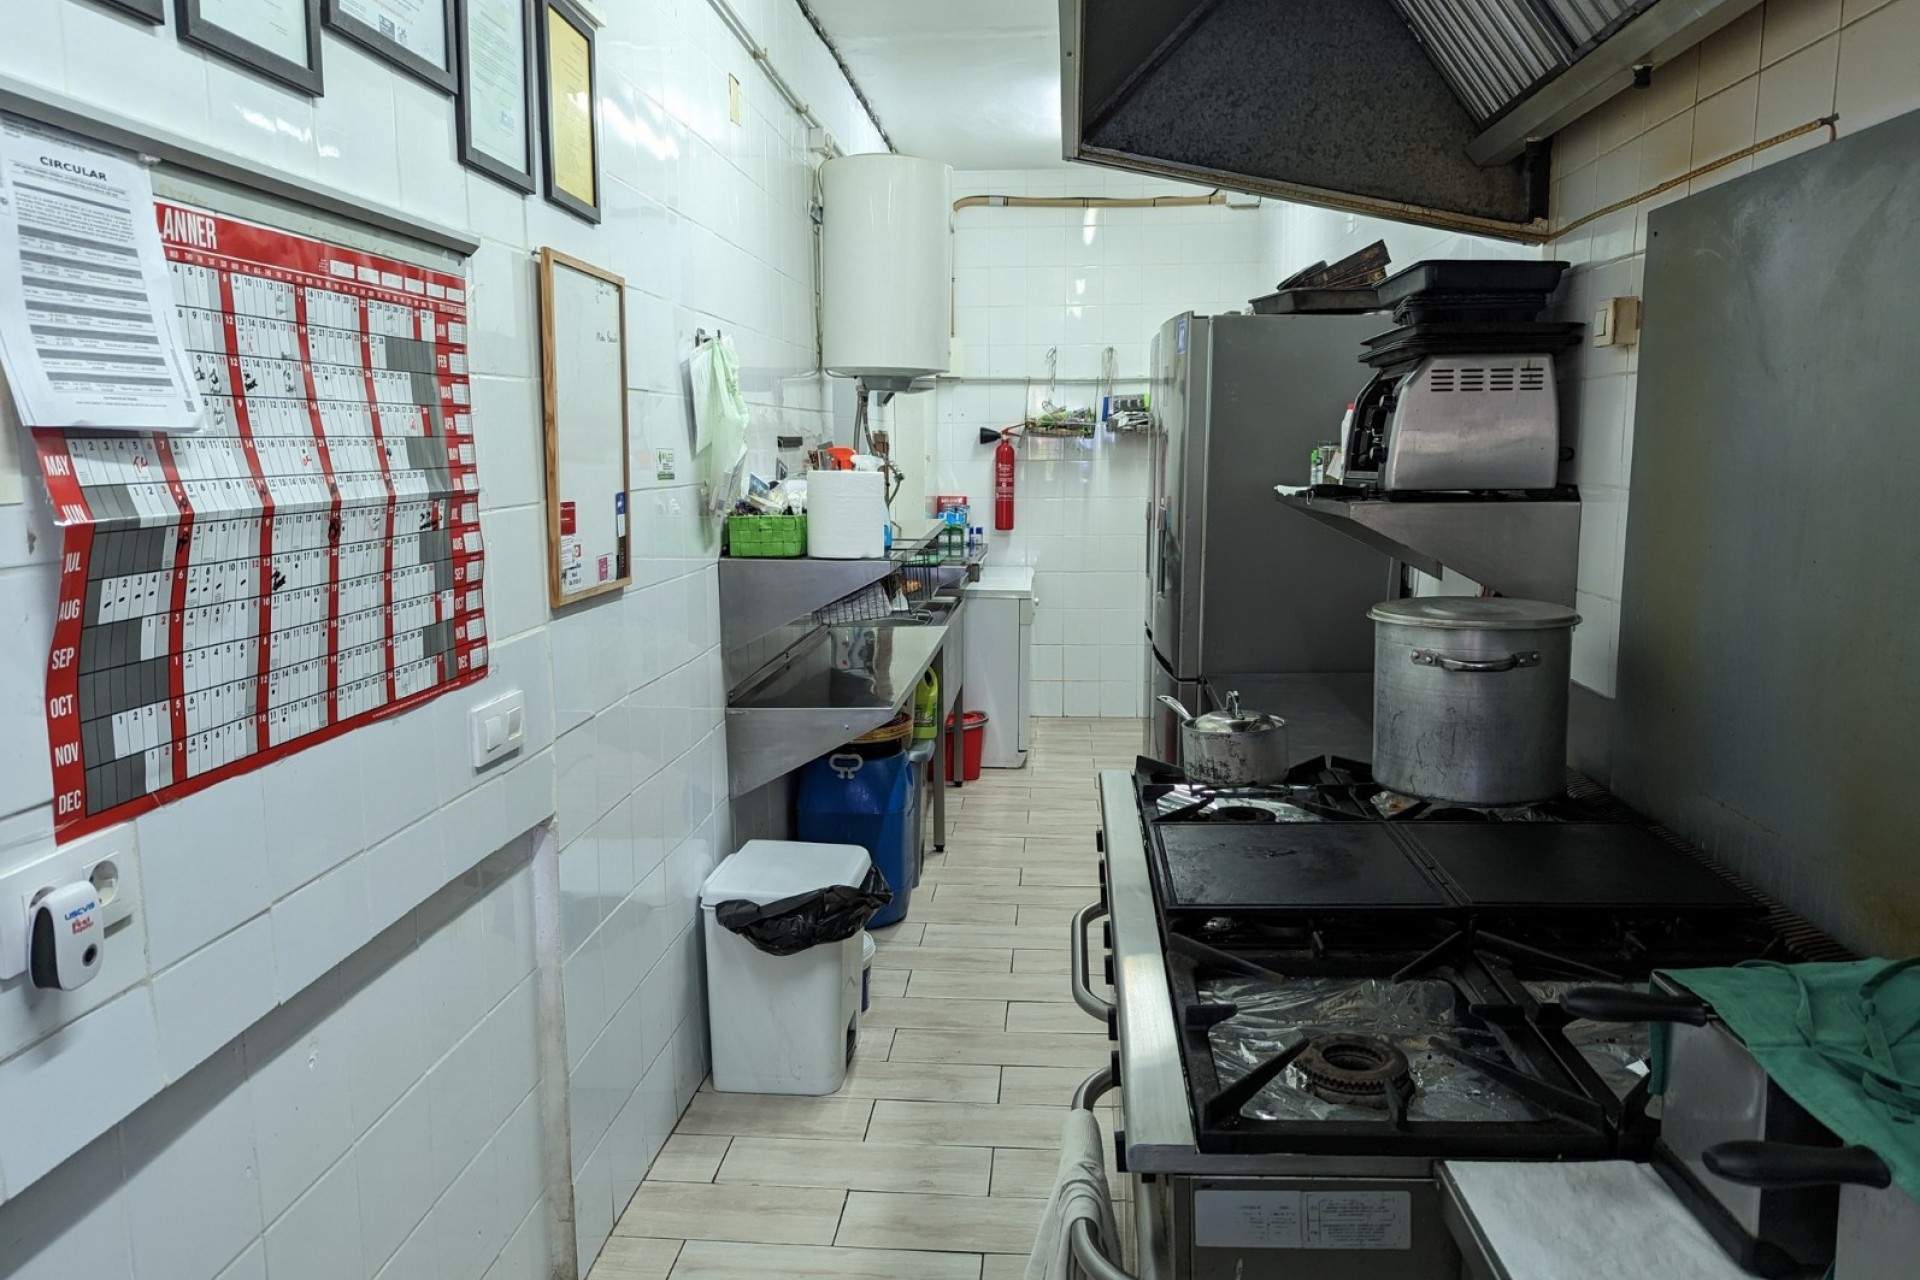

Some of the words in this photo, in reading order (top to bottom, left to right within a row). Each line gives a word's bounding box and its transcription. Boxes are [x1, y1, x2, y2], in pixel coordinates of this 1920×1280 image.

[40, 156, 107, 181] CIRCULAR
[160, 208, 217, 249] ANNER
[44, 455, 70, 476] MAY
[61, 504, 88, 524] JUN
[64, 552, 81, 574] JUL
[59, 599, 80, 622] AUG
[52, 647, 74, 670] SEP
[50, 694, 73, 718] OCT
[54, 741, 79, 768] NOV
[58, 789, 82, 815] DEC
